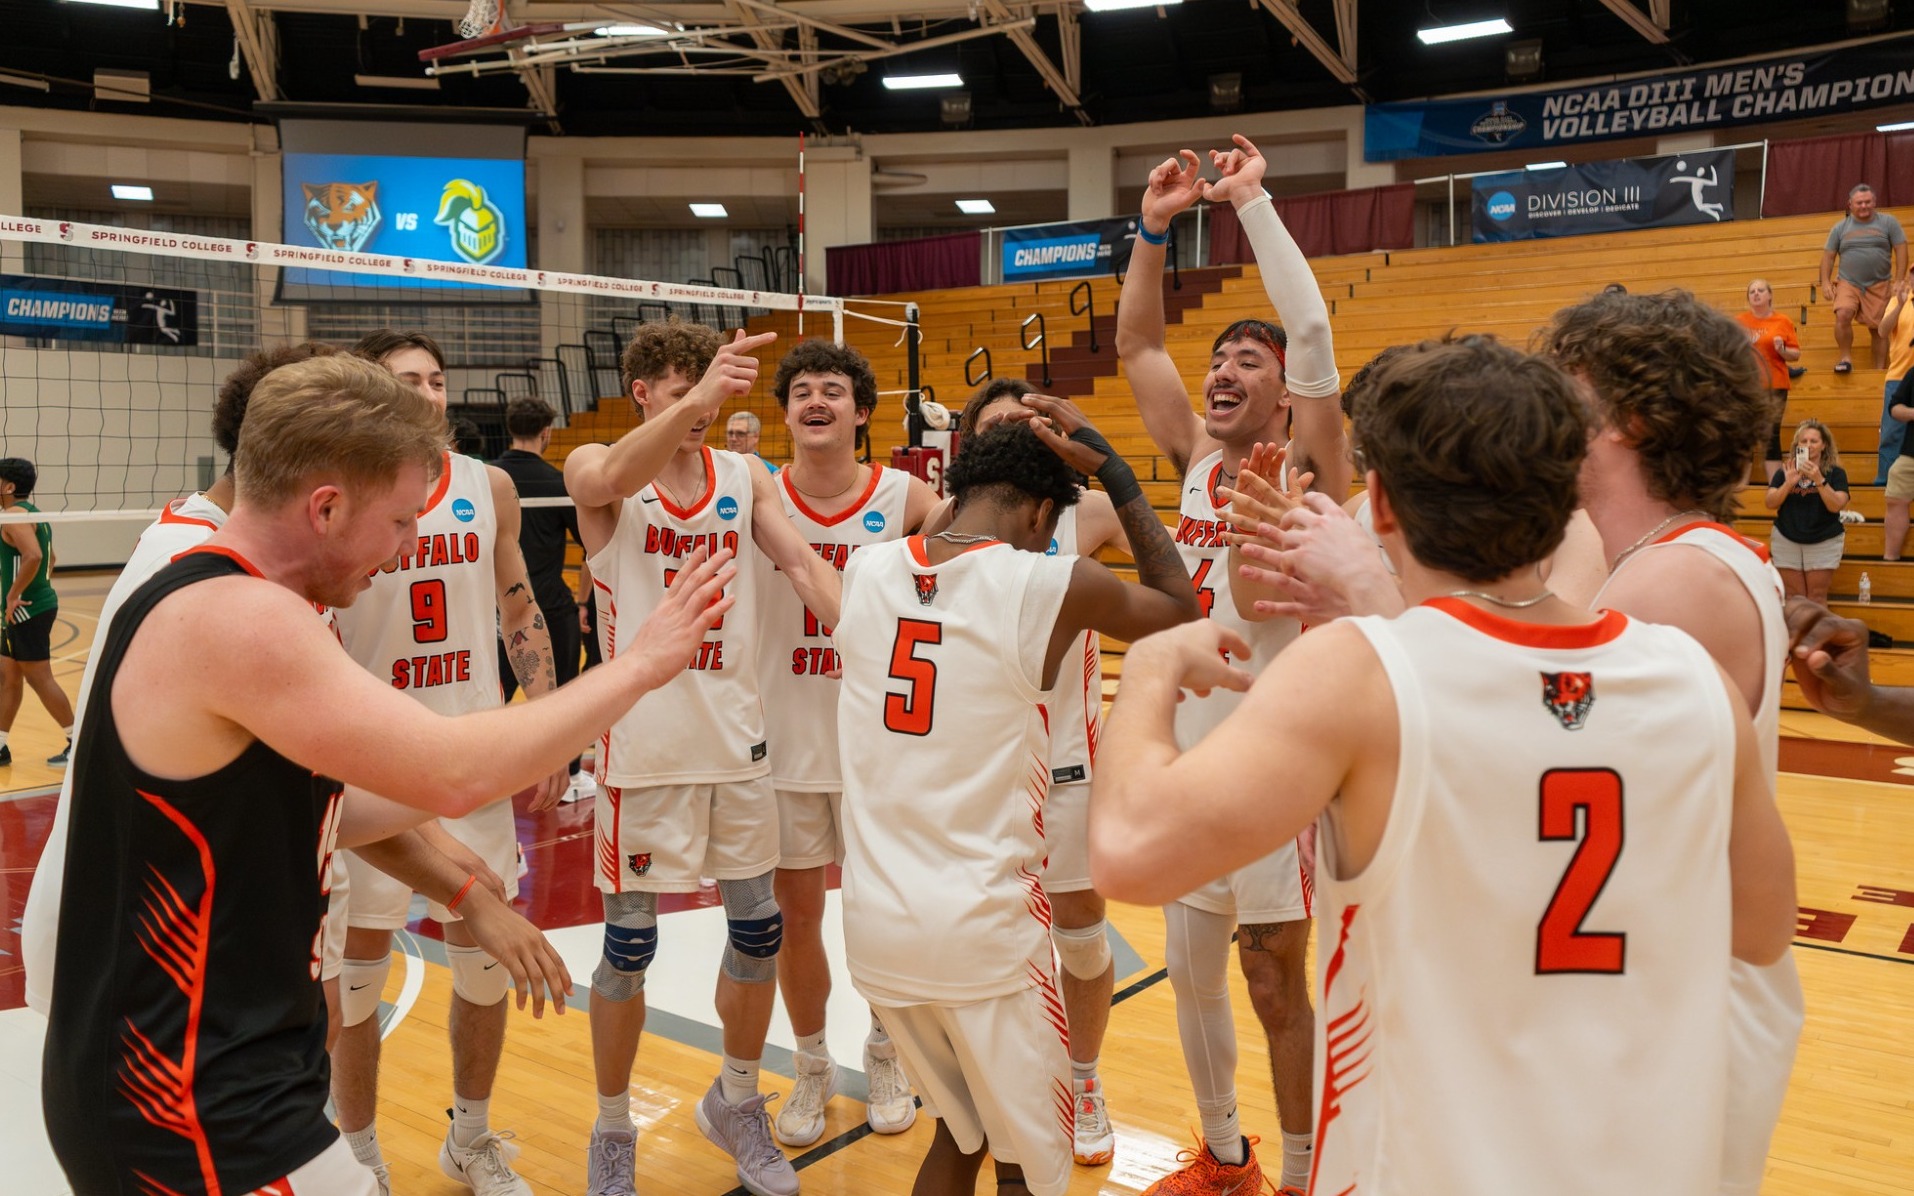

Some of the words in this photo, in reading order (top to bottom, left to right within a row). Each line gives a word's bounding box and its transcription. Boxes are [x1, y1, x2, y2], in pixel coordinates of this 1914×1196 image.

[1542, 88, 1621, 118] NCAA
[1627, 77, 1696, 108] DIII
[1703, 62, 1806, 98] MEN'S
[1543, 99, 1722, 141] VOLLEYBALL
[1731, 69, 1914, 119] CHAMPION
[1490, 203, 1516, 215] NCAA
[1528, 187, 1616, 211] DIVISION
[1624, 185, 1640, 203] III
[395, 212, 418, 231] VS
[1528, 210, 1561, 219] DISCOVER
[1567, 207, 1599, 216] DEVELOP
[1605, 203, 1639, 213] DEDICATE
[91, 231, 177, 248] SPRINGFIELD
[182, 241, 233, 253] COLLEGE
[273, 249, 344, 263] SPRINGFIELD
[349, 256, 392, 268] COLLEGE
[1014, 242, 1096, 267] CHAMPIONS
[427, 264, 486, 277] SPRINGFIELD
[490, 270, 528, 281] COLLEGE
[557, 277, 609, 289] SPRINGFIELD
[611, 282, 643, 293] COLLEGE
[669, 287, 714, 299] SPRINGFIELD
[717, 291, 745, 300] COLLEGE
[7, 298, 110, 322] CHAMPIONS
[456, 508, 474, 517] NCAA
[719, 506, 738, 515] NCAA
[866, 519, 883, 528] NCAA
[368, 532, 479, 576] FALO
[1191, 558, 1215, 618] 4
[410, 578, 447, 644] 9
[392, 650, 471, 689] STATE
[792, 647, 843, 675] STA
[884, 616, 942, 737] 5
[1536, 767, 1626, 975] 2
